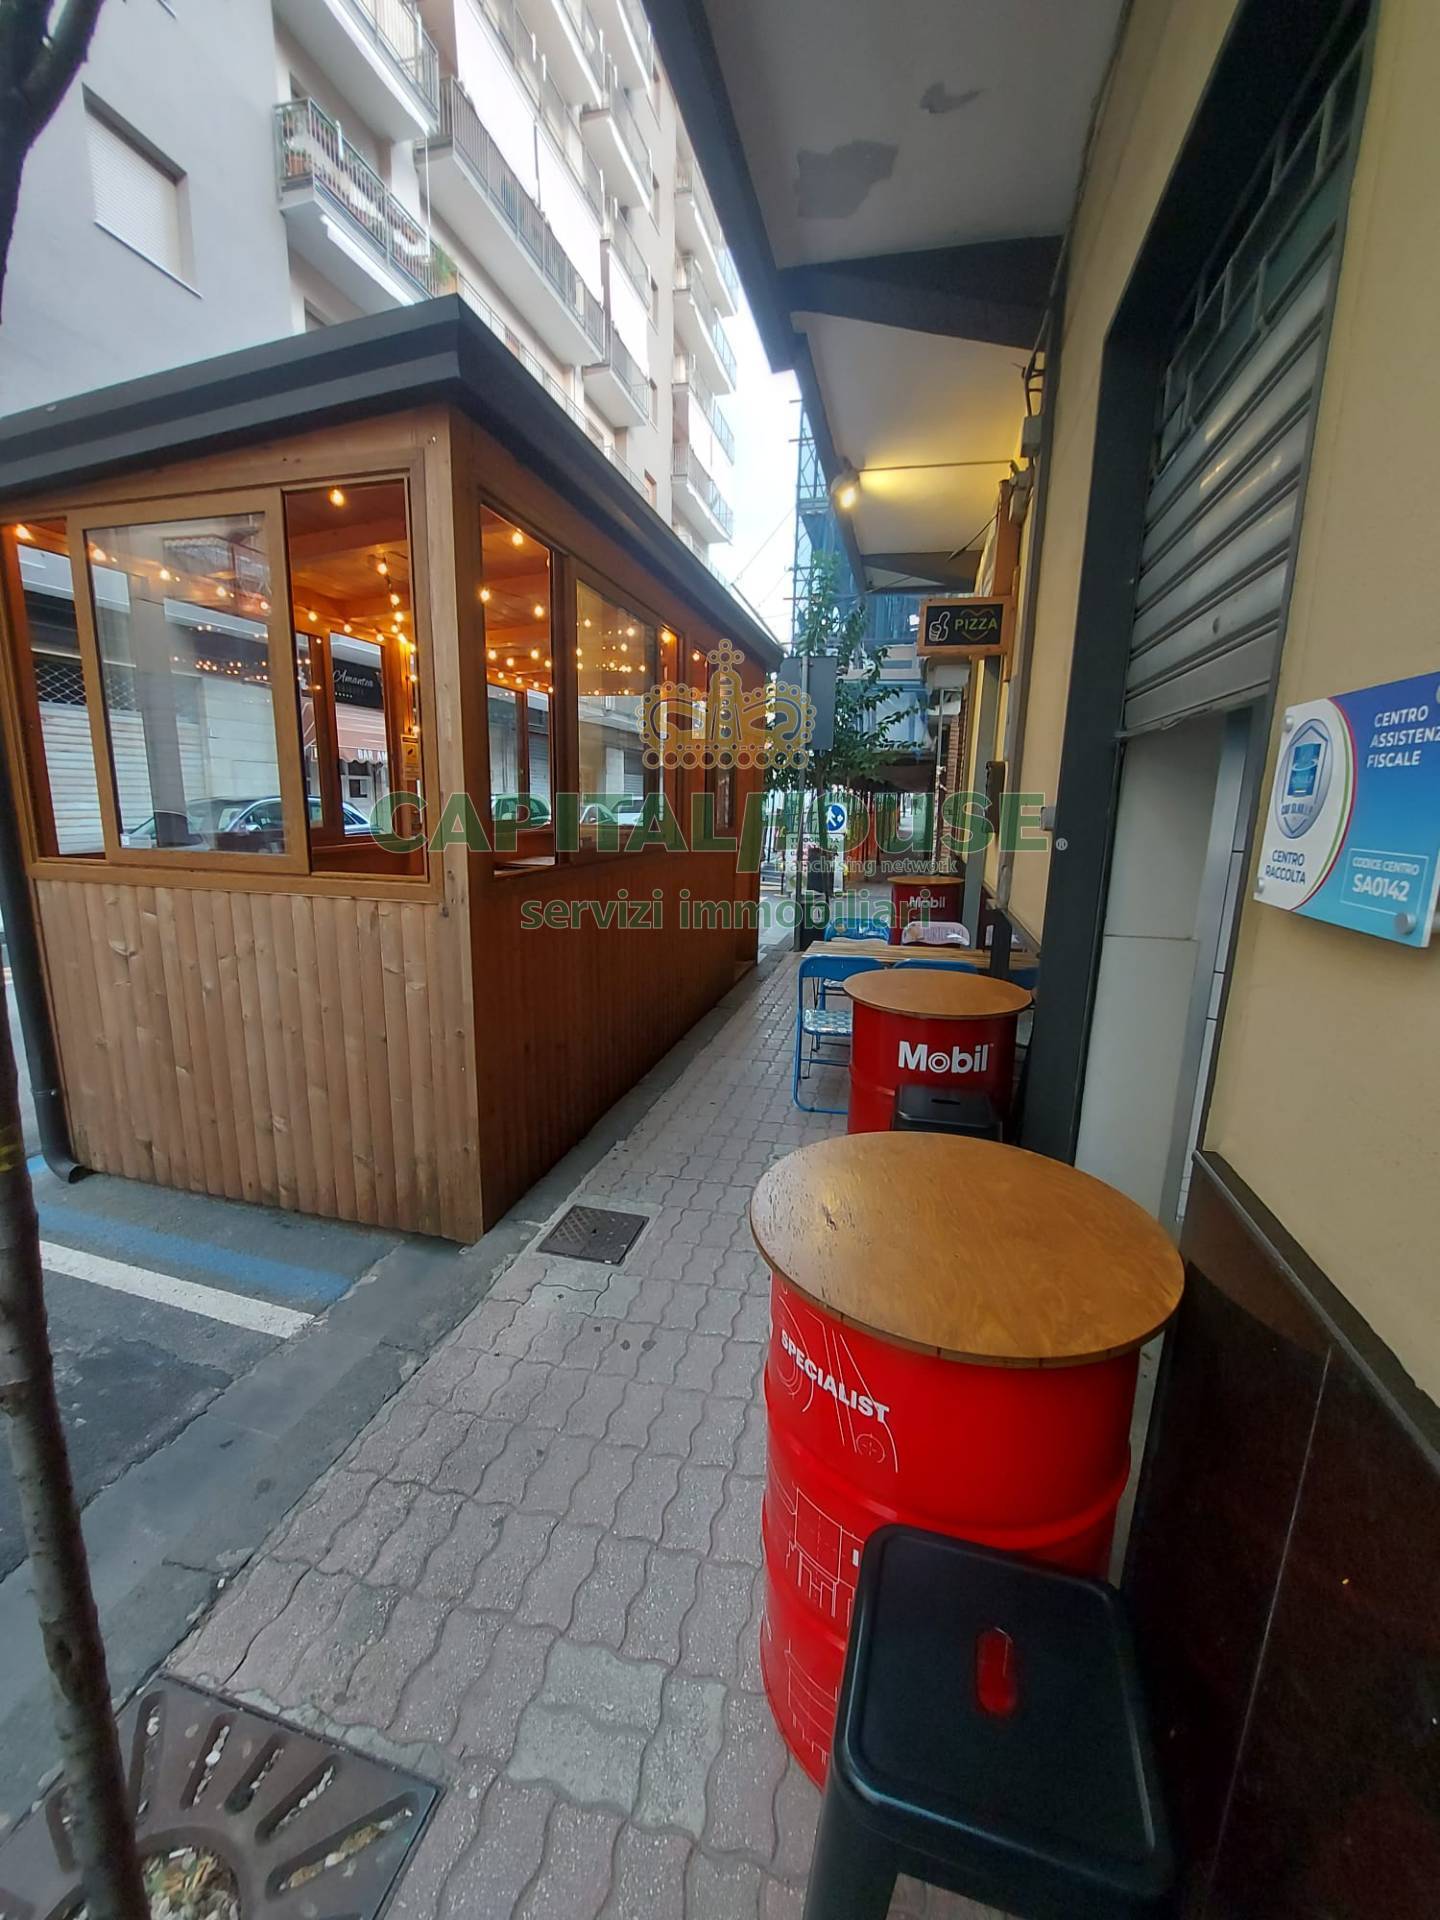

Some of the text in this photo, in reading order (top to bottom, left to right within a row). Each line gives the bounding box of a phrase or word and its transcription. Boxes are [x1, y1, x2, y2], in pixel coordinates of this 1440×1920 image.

[955, 618, 998, 631] PIZZA
[1374, 705, 1429, 728] CENTRO
[1369, 726, 1440, 748] ASSISTENZ
[1366, 750, 1422, 769] FISCALE
[1272, 849, 1305, 866] CENTRO
[1265, 864, 1306, 885] RACCOLTA
[909, 895, 946, 909] Mobil
[898, 1040, 990, 1074] Mobil
[780, 1328, 890, 1424] SPECIALIST
